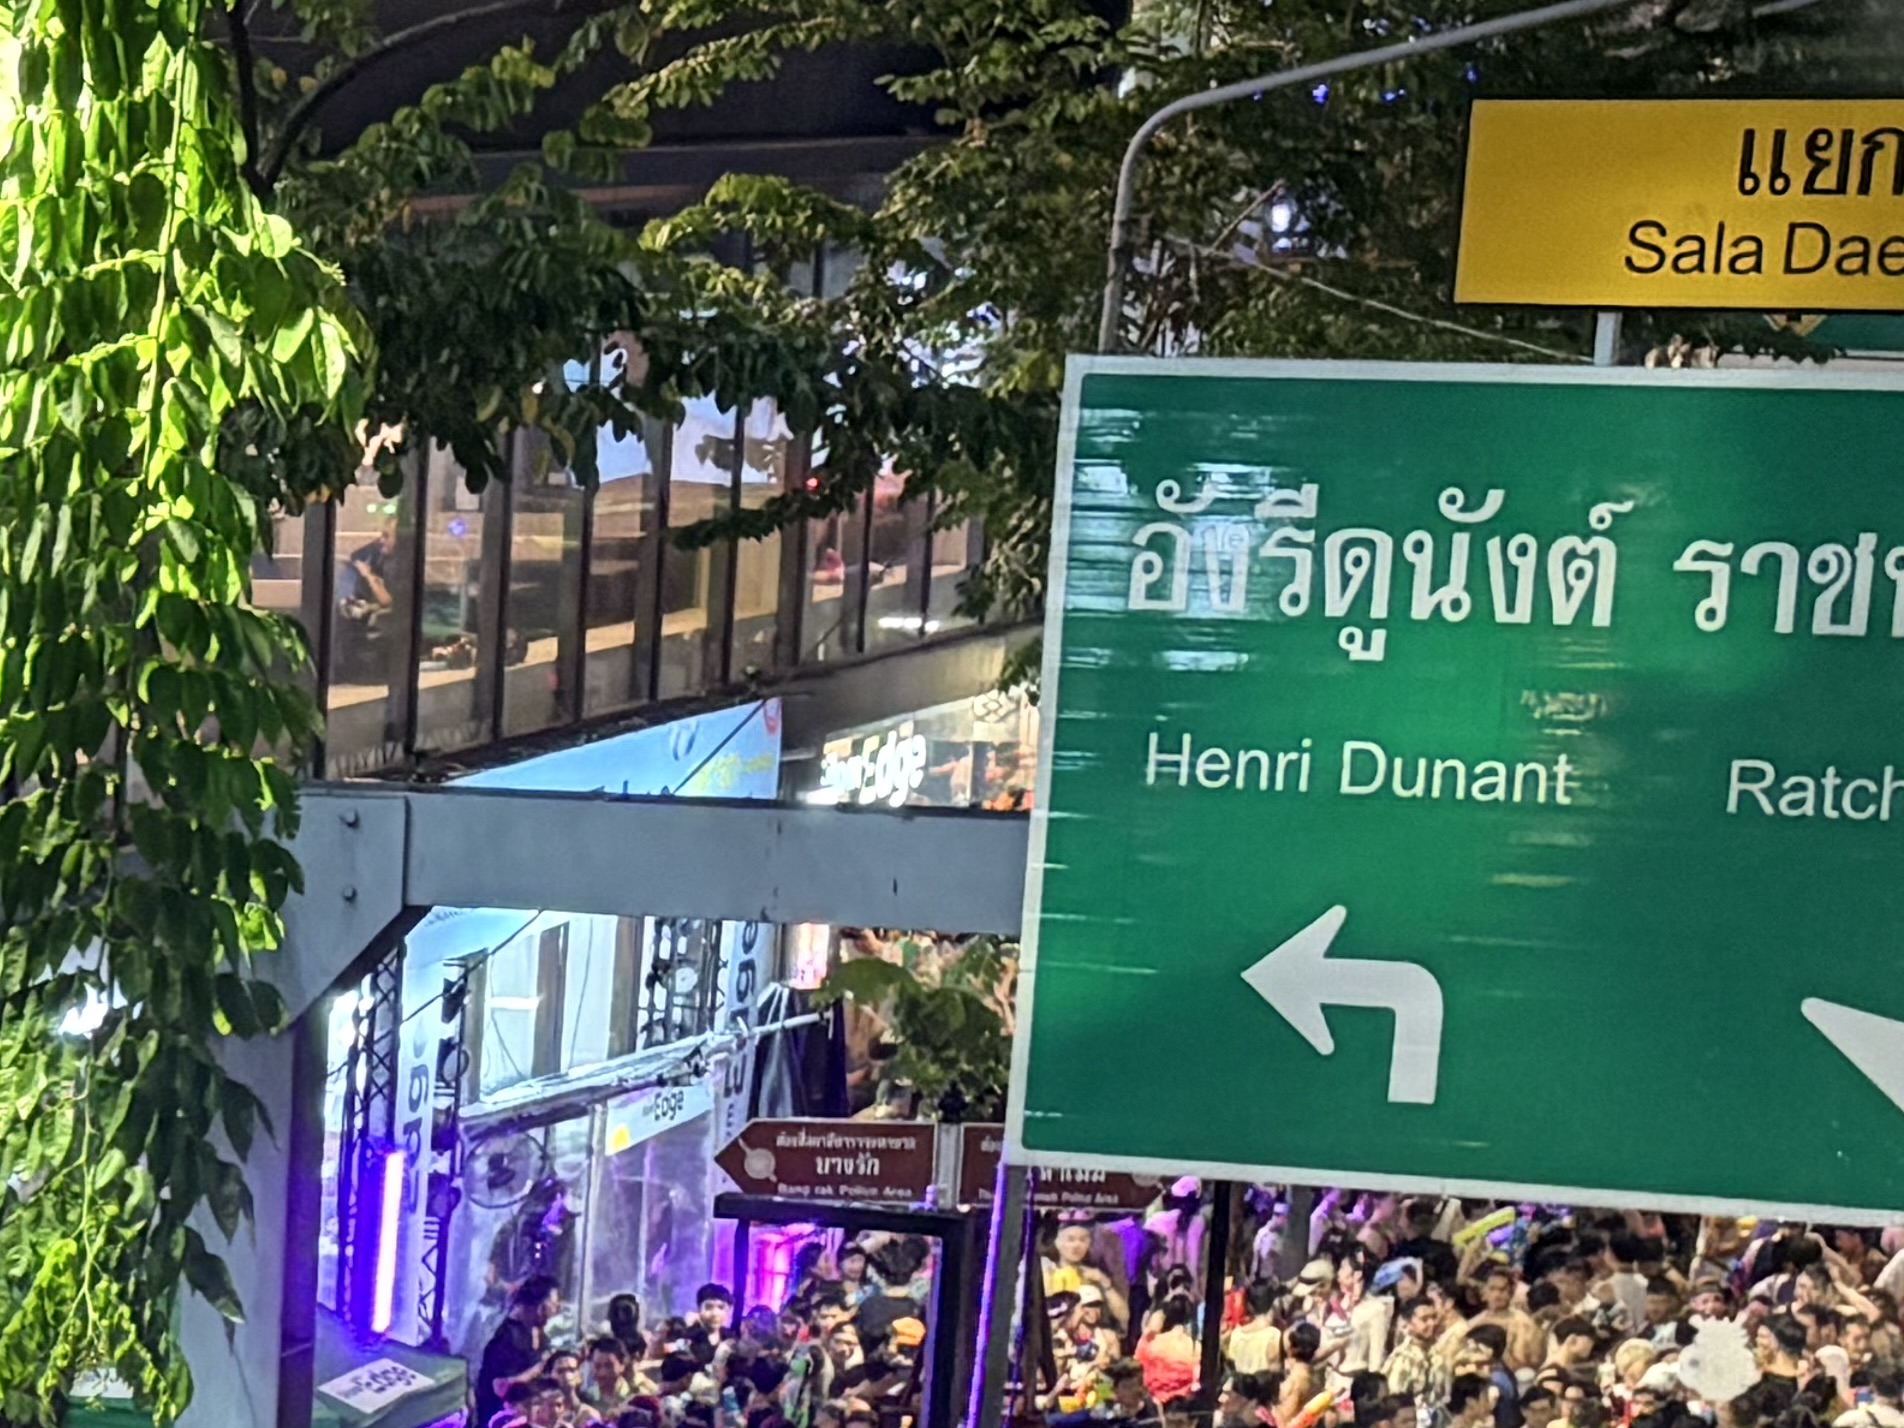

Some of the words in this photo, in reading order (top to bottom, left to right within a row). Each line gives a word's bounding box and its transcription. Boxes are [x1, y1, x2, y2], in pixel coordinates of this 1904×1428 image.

[1738, 127, 1904, 197] แยก
[1624, 219, 1764, 276] Sala
[1783, 221, 1904, 278] Dae
[1127, 478, 1636, 662] อังรีดูนังต์
[858, 730, 927, 808] Edge
[1145, 730, 1314, 793] Henri
[1339, 739, 1573, 806] Dunant
